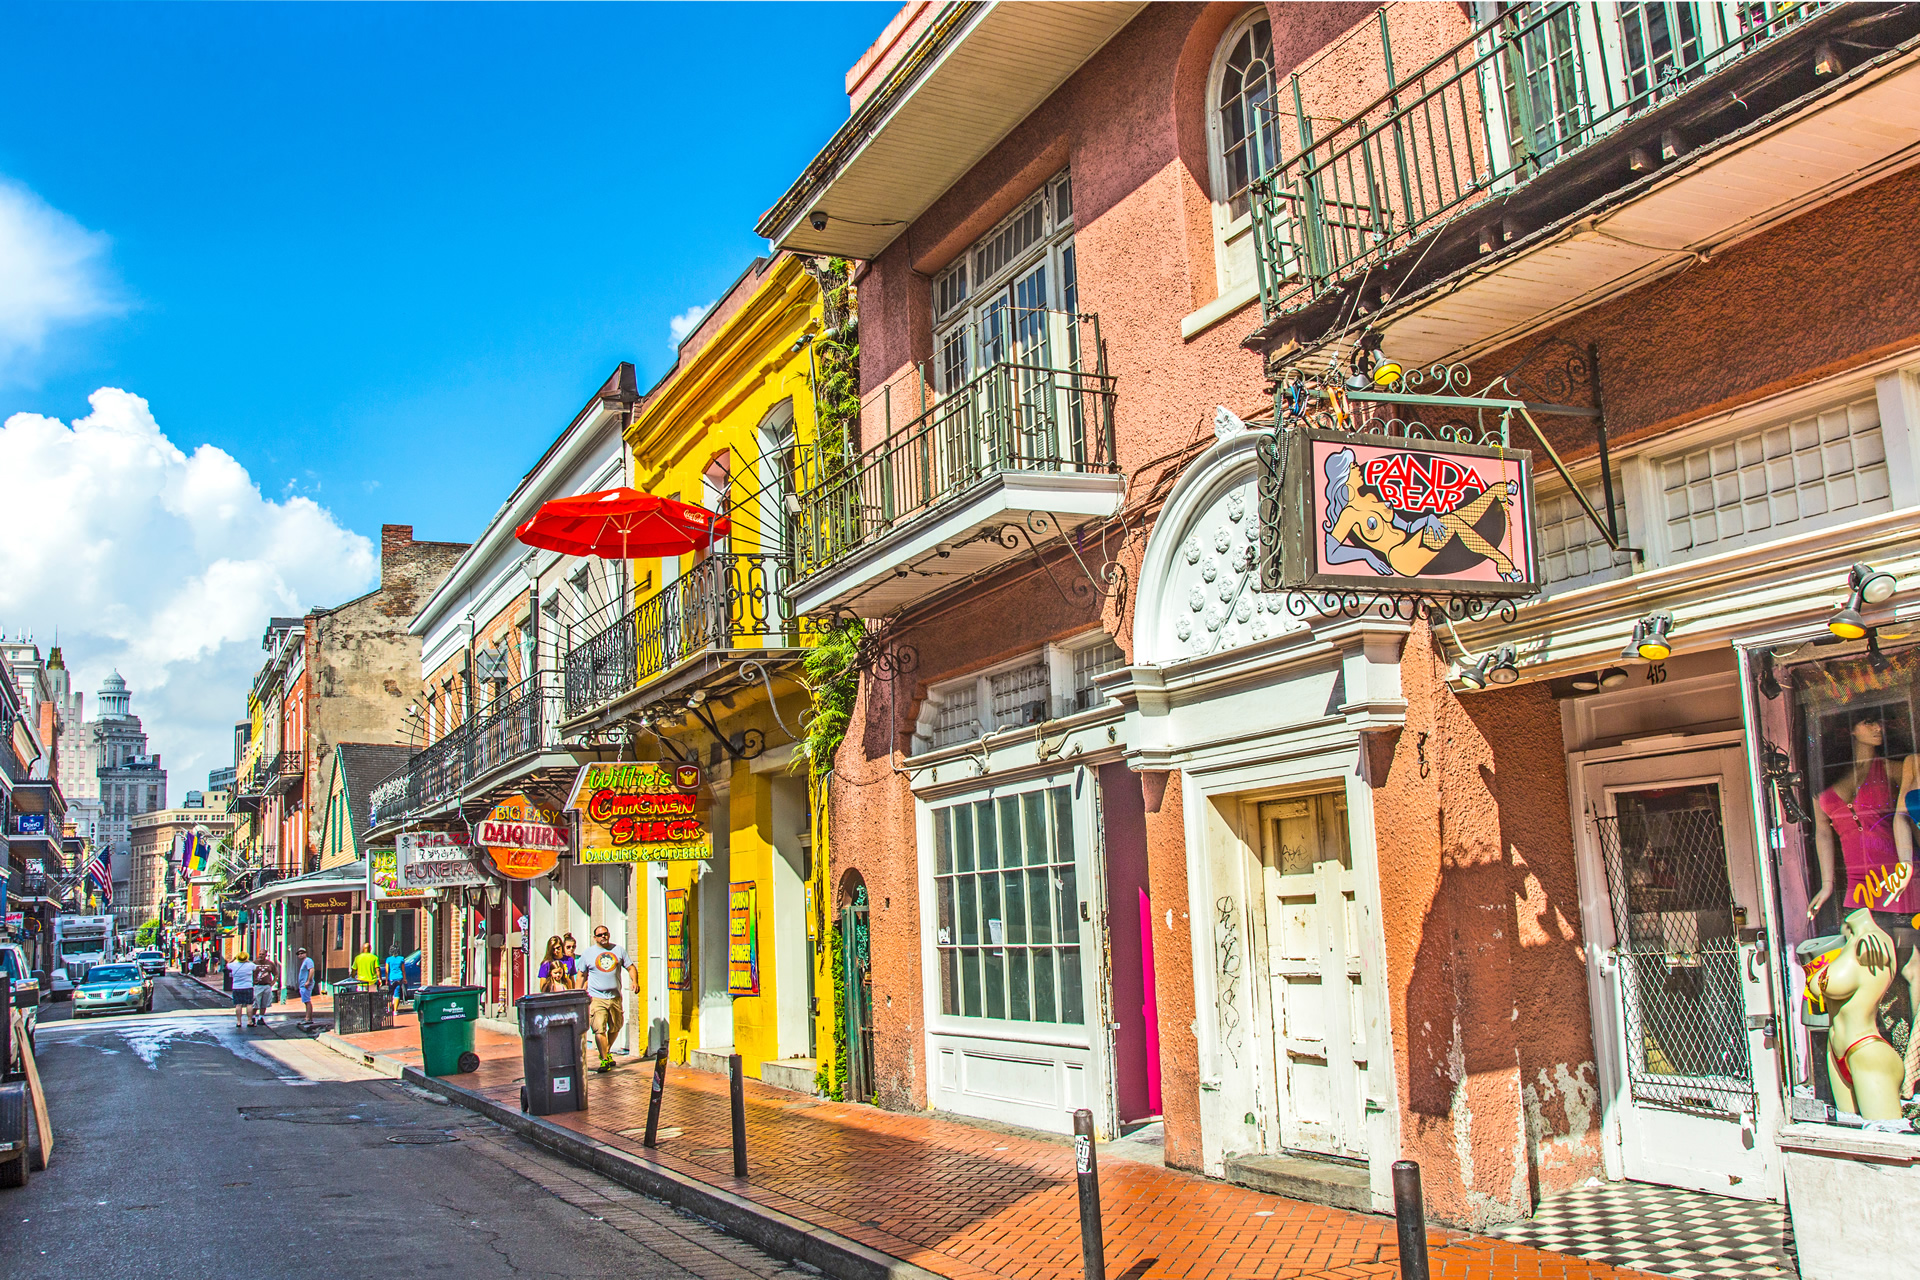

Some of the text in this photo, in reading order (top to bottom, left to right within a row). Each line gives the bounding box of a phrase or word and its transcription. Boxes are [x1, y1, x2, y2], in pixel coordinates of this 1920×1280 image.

[1364, 454, 1487, 495] PANDA
[1379, 482, 1464, 514] BEAR
[1646, 662, 1667, 685] 415
[589, 766, 672, 789] Willie's
[495, 805, 560, 824] BIG EASY
[415, 833, 474, 847] JAZZ
[482, 823, 569, 847] DAIQUIRIS
[507, 850, 540, 867] PIZZA
[585, 846, 708, 862] DAIQUIRIS & COLD BEER
[404, 861, 487, 880] FUNERAL
[1853, 863, 1908, 909] Who
[304, 897, 348, 909] Famous Door
[378, 901, 411, 909] WELCOME
